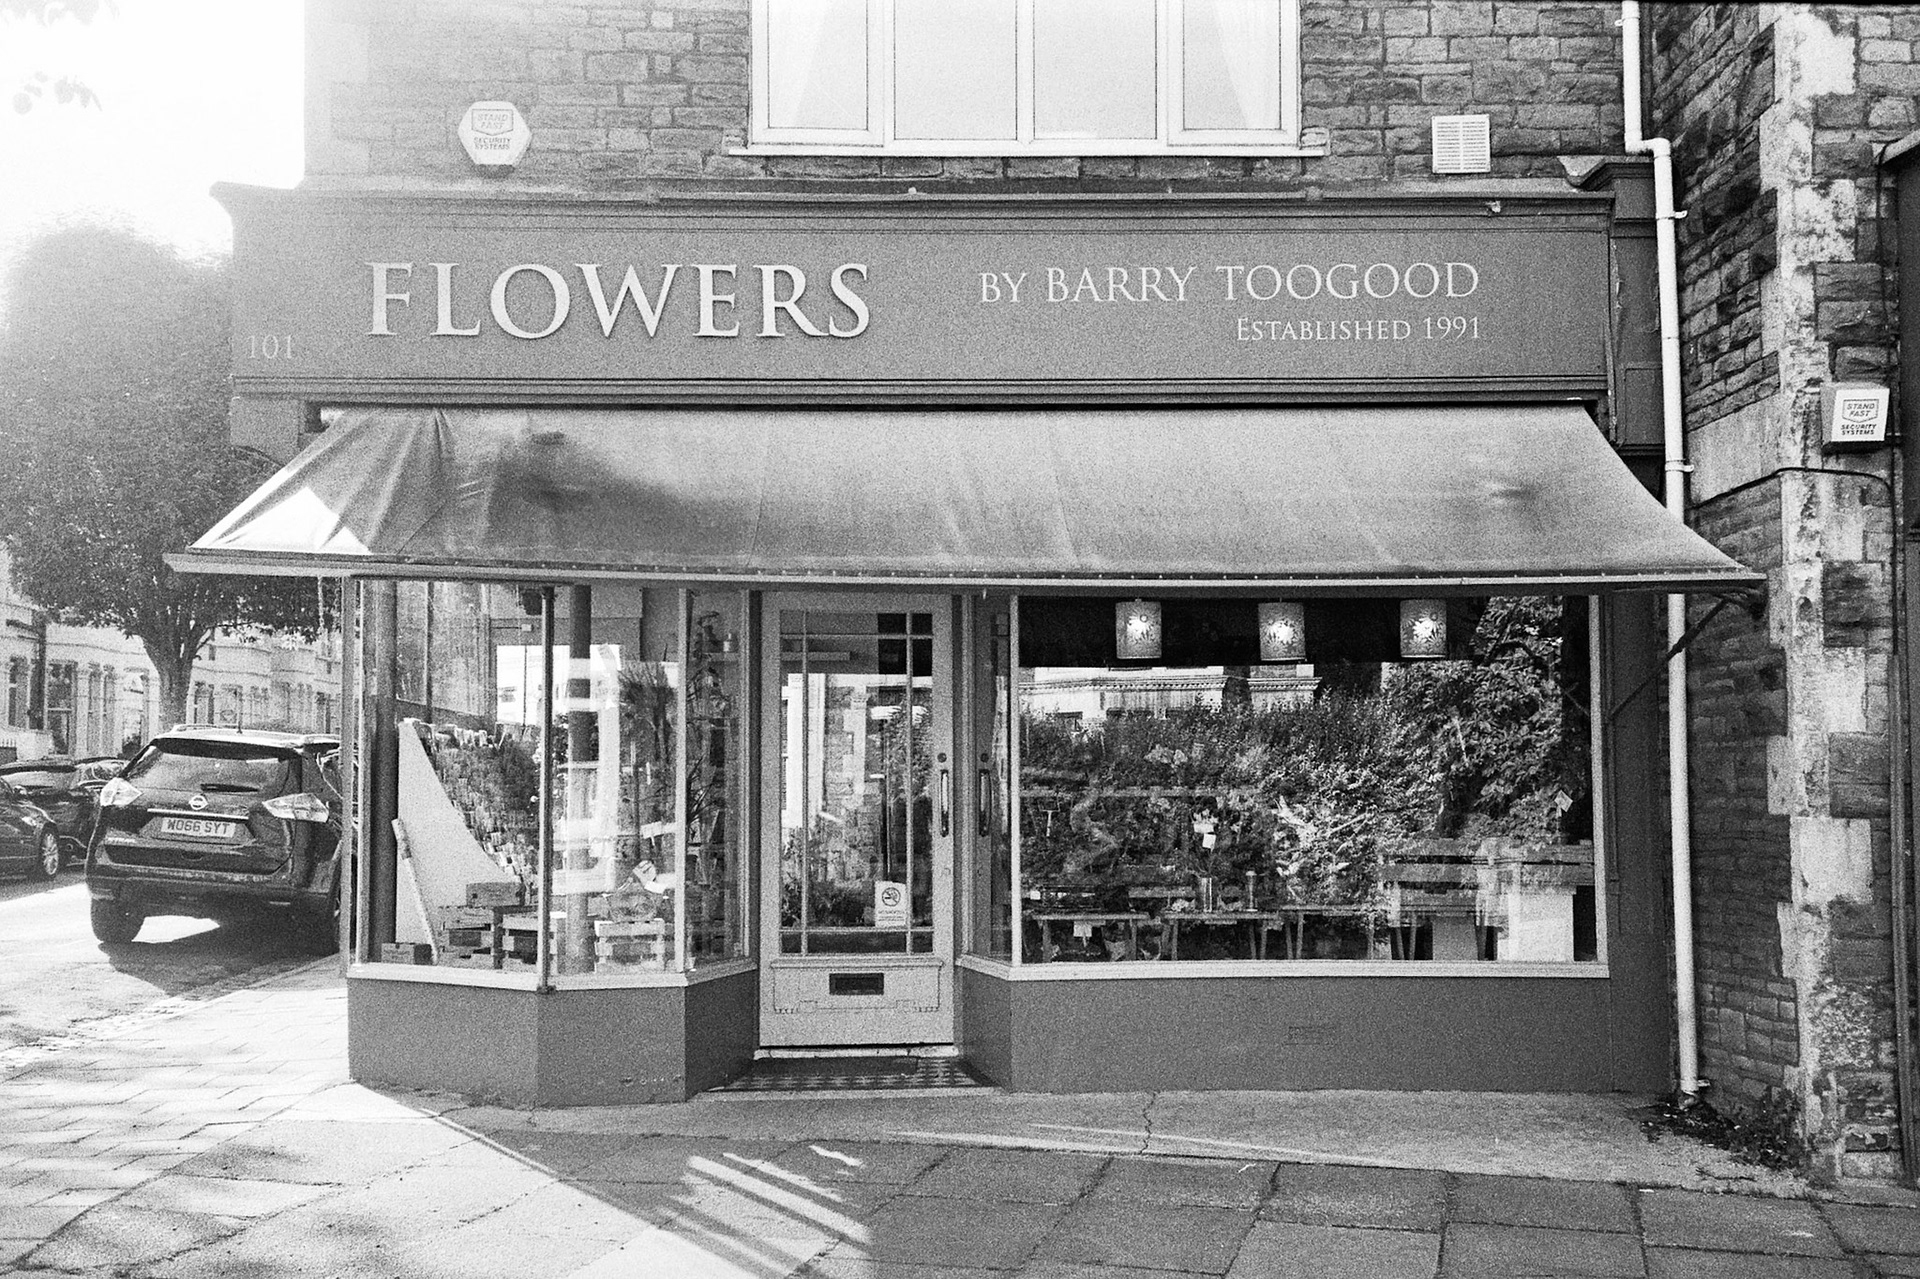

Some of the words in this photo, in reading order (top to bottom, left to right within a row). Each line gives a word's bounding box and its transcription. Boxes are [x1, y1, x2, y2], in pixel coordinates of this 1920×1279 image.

[980, 272, 1027, 302] BY
[1047, 266, 1197, 301] BARRY
[1215, 262, 1479, 301] TOOGOOD
[364, 262, 870, 339] FLOWERS
[1237, 317, 1411, 341] ESTABLISHED
[1423, 316, 1479, 341] 1991
[247, 334, 293, 359] 101
[204, 821, 230, 834] SYT
